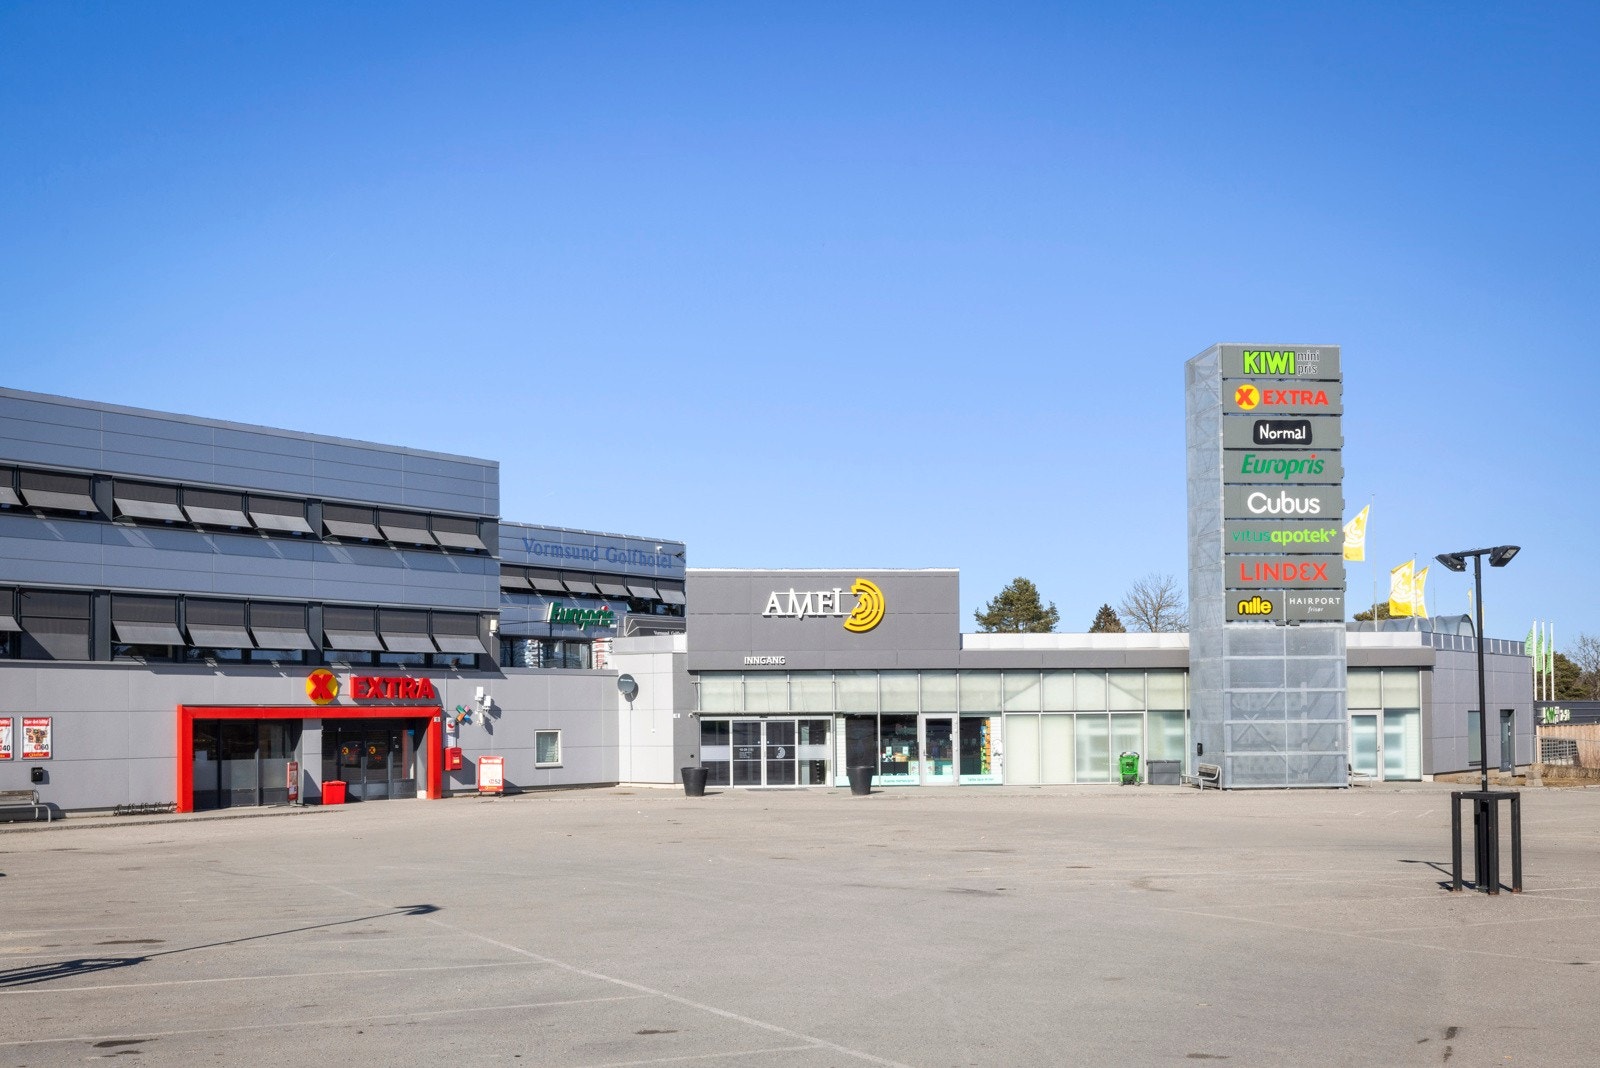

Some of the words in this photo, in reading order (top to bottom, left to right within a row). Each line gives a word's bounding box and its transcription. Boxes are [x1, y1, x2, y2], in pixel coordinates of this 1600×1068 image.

[1243, 350, 1295, 375] KIWI
[1296, 349, 1320, 361] mini
[1296, 362, 1318, 376] pris
[1262, 389, 1329, 406] EXTRA
[1259, 423, 1306, 440] Normal
[1241, 453, 1325, 480] Europris
[1247, 490, 1321, 514] Cubus
[521, 537, 599, 562] Vormsund
[605, 546, 673, 569] Golfhotel
[1240, 562, 1329, 581] LINDEX
[762, 588, 842, 618] AMFI
[1237, 595, 1273, 615] nille
[1289, 597, 1341, 605] HAIRPORT
[547, 601, 615, 630] Europris
[744, 656, 786, 665] INNGANG
[349, 676, 436, 699] EXTRA
